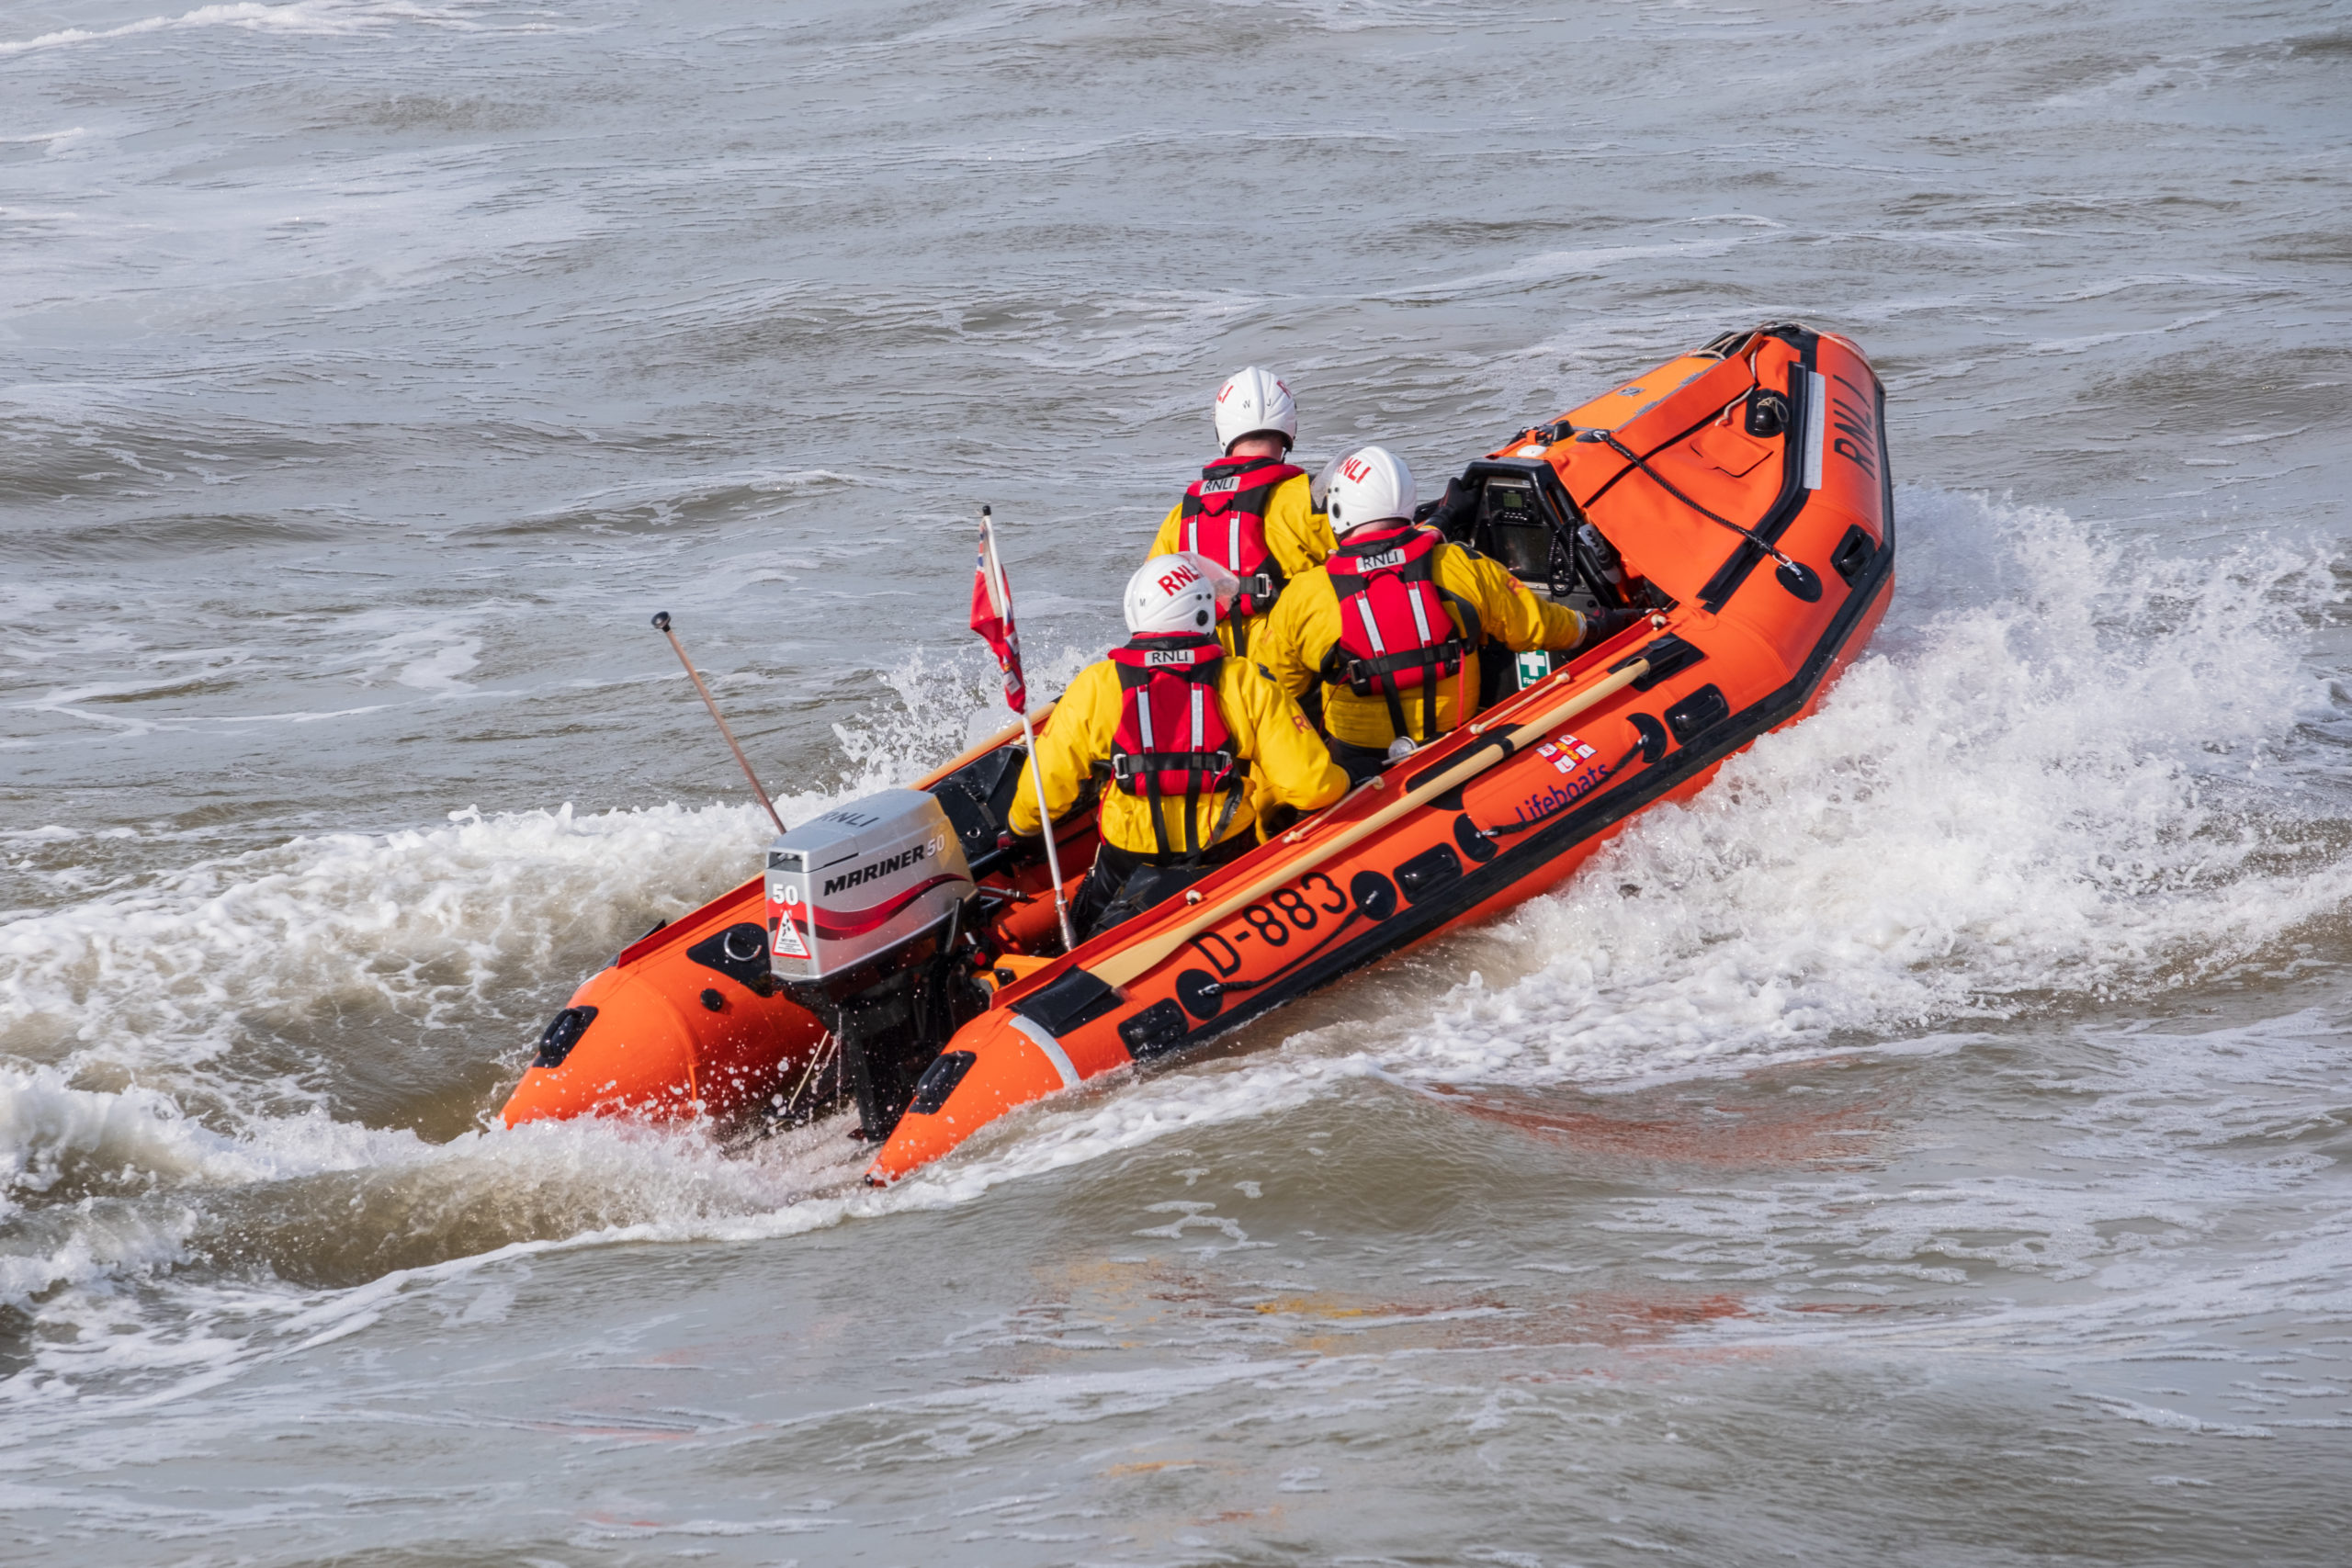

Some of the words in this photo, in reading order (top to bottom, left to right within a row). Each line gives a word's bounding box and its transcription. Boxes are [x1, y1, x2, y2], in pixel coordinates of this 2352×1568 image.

[1833, 374, 1876, 480] RNLI
[1204, 478, 1235, 492] RNLI
[1363, 553, 1398, 570] RNLI
[1151, 650, 1188, 663] RNLI
[1515, 764, 1609, 823] Lifeboats
[823, 843, 925, 897] MARINER
[926, 834, 945, 857] 50
[772, 883, 799, 906] 50
[1187, 872, 1347, 978] D-883
